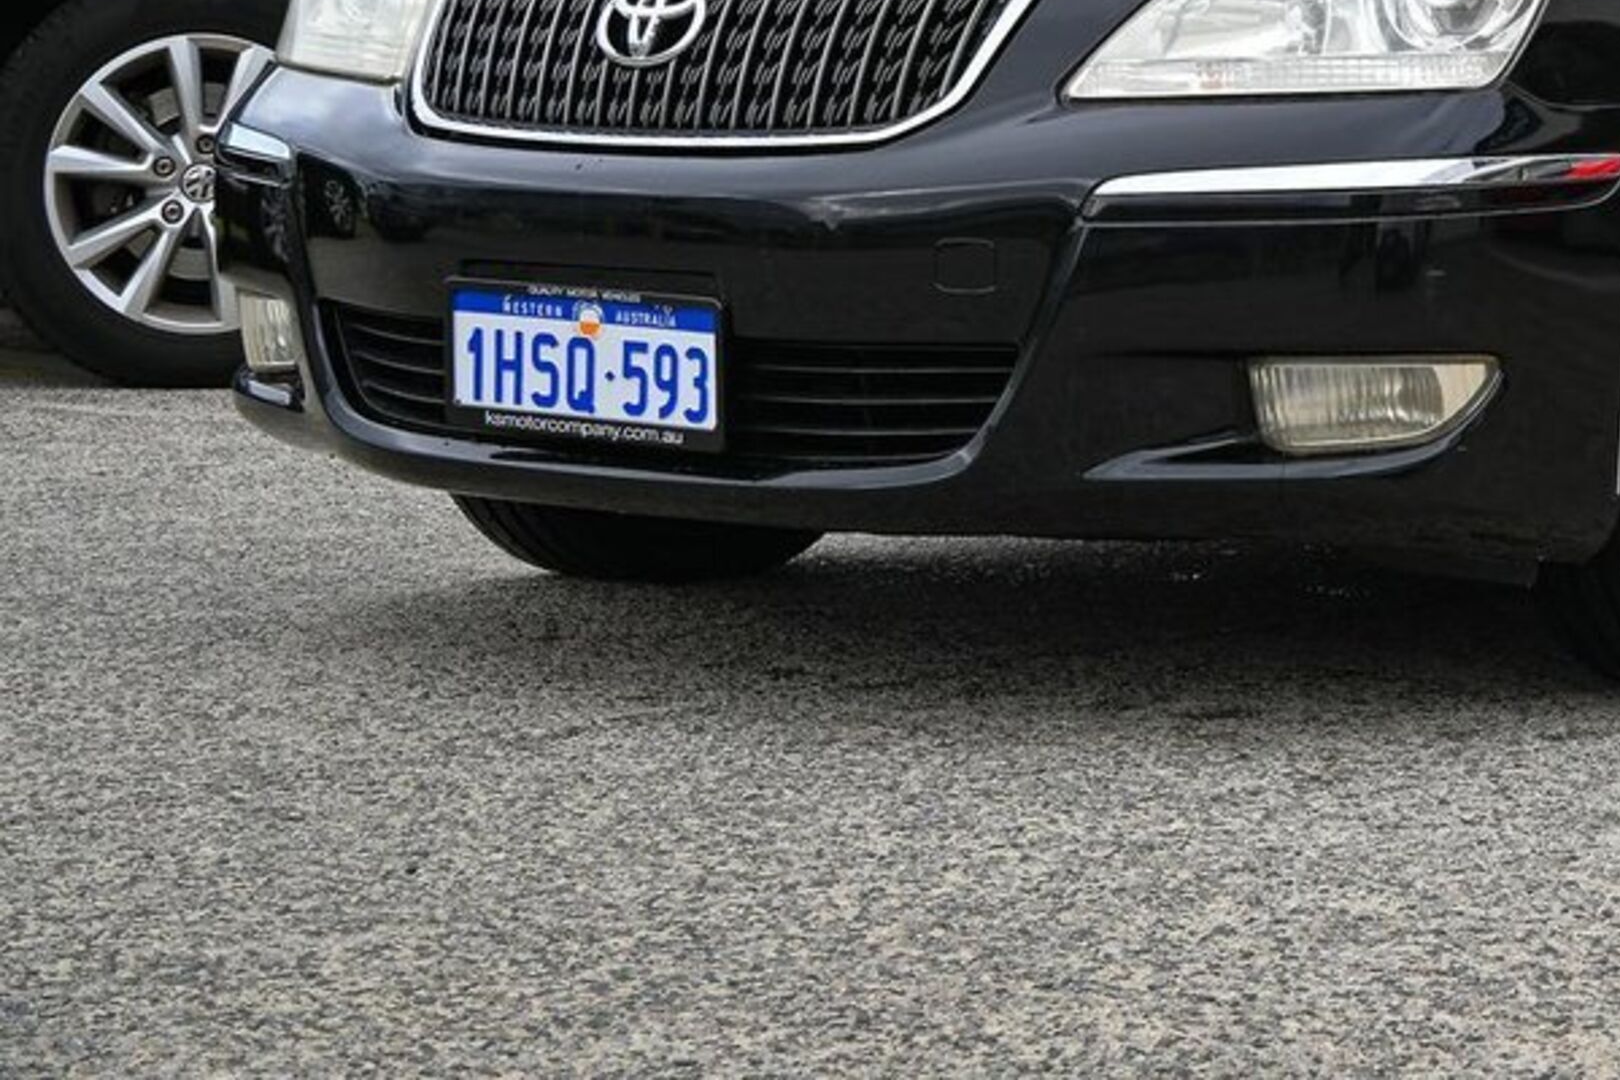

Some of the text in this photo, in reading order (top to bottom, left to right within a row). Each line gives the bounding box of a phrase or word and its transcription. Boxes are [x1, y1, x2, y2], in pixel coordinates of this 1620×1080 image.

[503, 297, 677, 328] WESTERN AUSTRALIA
[484, 410, 684, 444] ksmotorcompany.com.au
